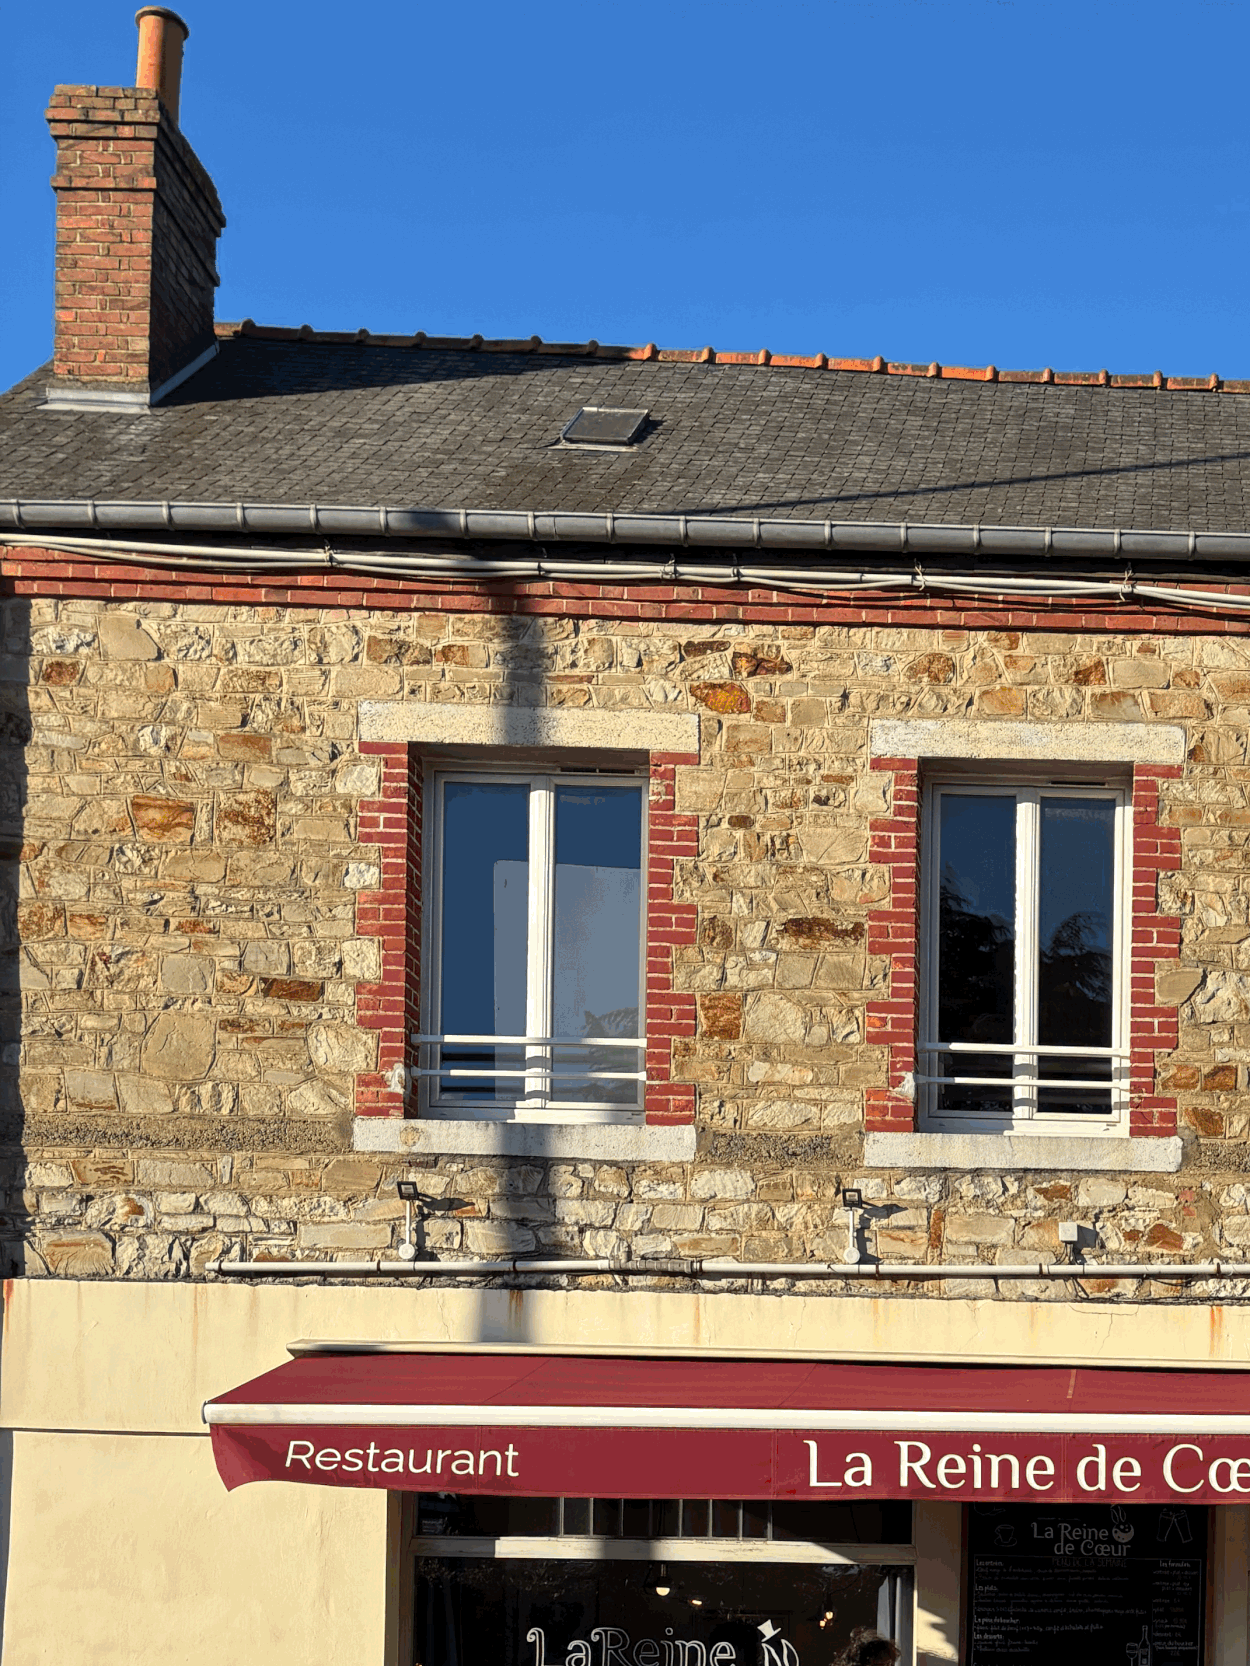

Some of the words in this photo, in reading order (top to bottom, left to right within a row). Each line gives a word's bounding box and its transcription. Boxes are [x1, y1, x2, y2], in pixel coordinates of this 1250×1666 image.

[285, 1440, 519, 1477] Restaurant
[803, 1439, 872, 1488] La
[894, 1440, 1055, 1491] Reine
[1076, 1444, 1141, 1492] de
[1030, 1522, 1054, 1539] La
[1057, 1522, 1109, 1541] Reine
[1053, 1538, 1075, 1556] de
[1080, 1539, 1132, 1557] Cœur
